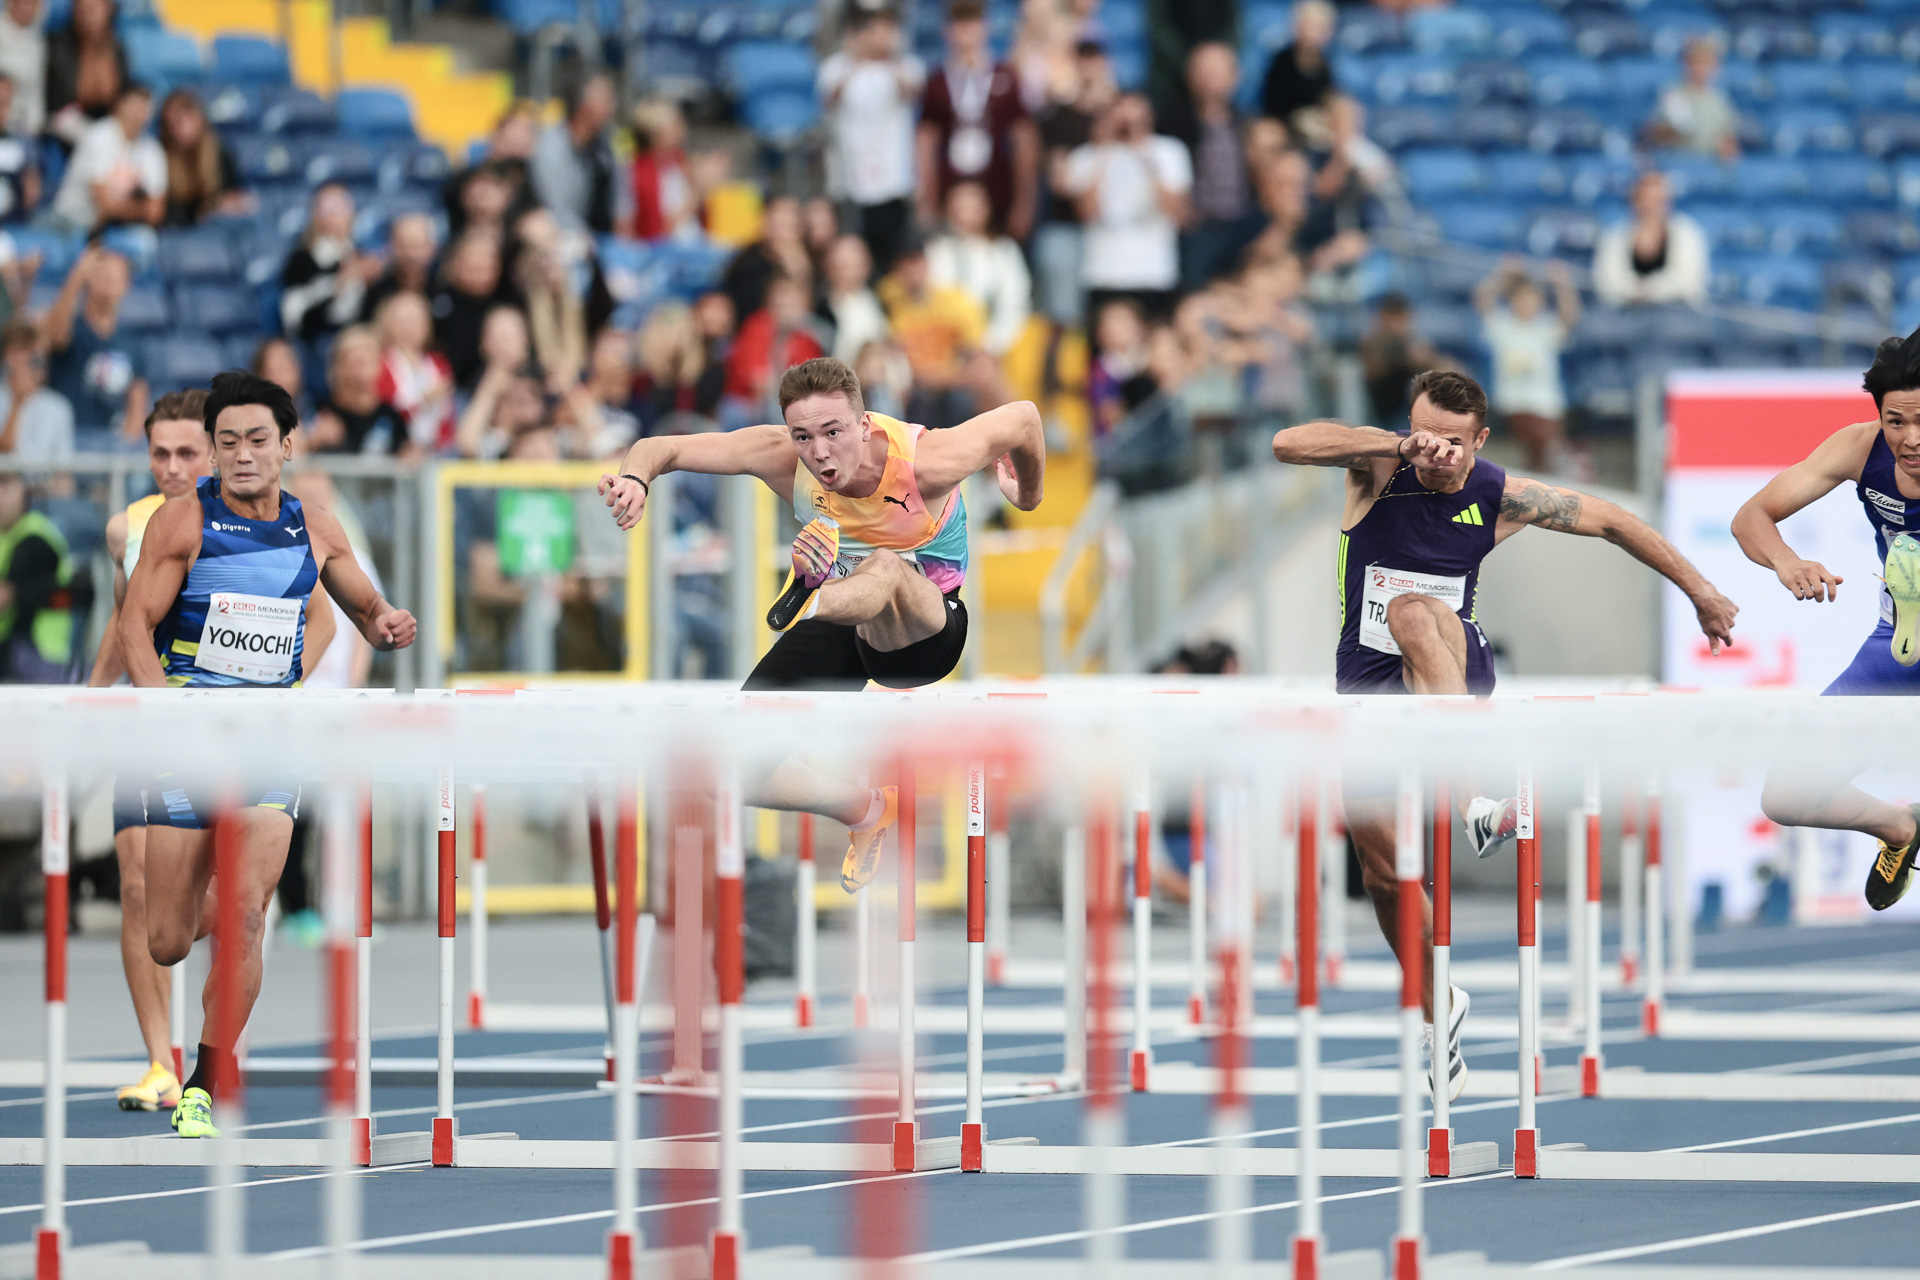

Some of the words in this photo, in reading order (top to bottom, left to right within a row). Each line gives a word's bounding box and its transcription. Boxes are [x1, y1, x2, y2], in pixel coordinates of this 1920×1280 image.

[1390, 577, 1414, 588] ORLEN
[209, 625, 293, 655] YOKOCHI
[969, 769, 981, 814] polanik
